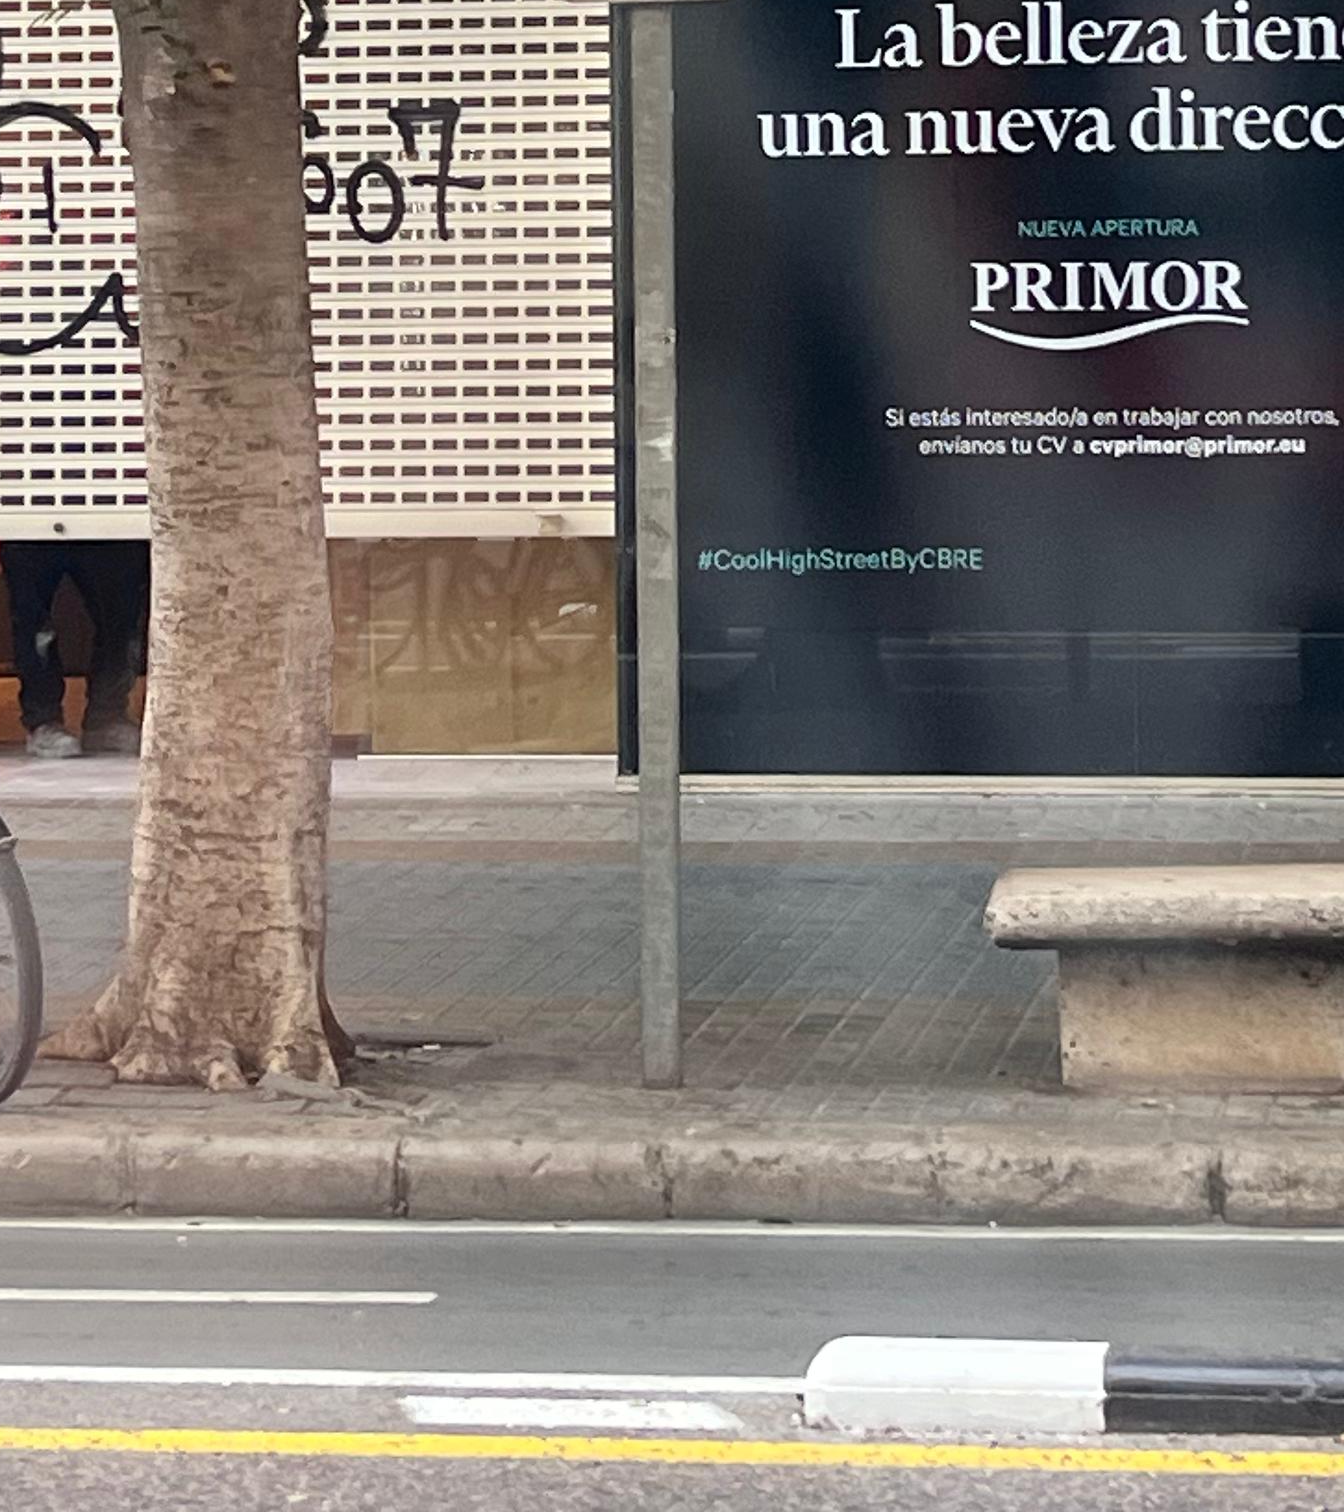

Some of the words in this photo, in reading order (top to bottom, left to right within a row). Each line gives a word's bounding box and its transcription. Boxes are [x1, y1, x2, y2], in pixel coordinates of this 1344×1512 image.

[833, 7, 925, 69] La
[934, 0, 1188, 68] belleza
[756, 111, 892, 159] una
[904, 107, 1117, 155] nueva
[1017, 219, 1087, 238] NUEVA
[1090, 218, 1200, 237] APERTURA
[970, 260, 1249, 312] PRIMOR
[885, 407, 905, 427] Si
[908, 406, 962, 427] estás
[965, 406, 1089, 428] interesado/a
[1092, 410, 1118, 427] en
[1122, 406, 1201, 431] trabajar
[1204, 409, 1243, 427] con
[1246, 408, 1340, 427] nosotros,
[918, 434, 1007, 455] envíanos
[1010, 436, 1033, 455] tu
[1036, 434, 1068, 455] CV
[1071, 439, 1086, 455] a
[1088, 434, 1307, 459] cvprimor@primor.eu
[698, 547, 984, 576] #CoolHighStreetByCBRE
